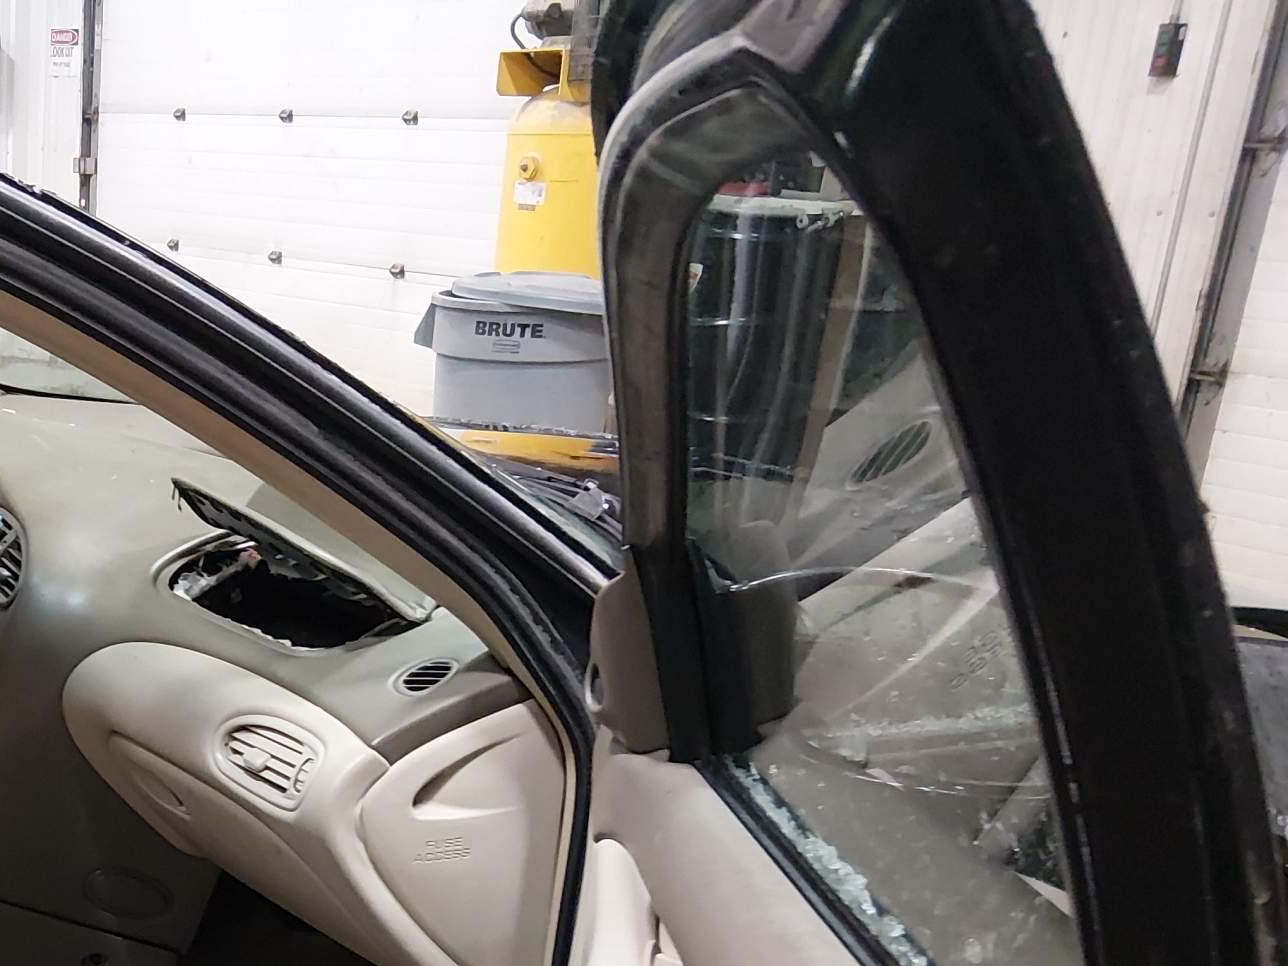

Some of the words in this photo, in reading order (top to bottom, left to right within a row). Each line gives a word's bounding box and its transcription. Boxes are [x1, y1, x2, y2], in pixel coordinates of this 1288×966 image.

[474, 320, 545, 339] BRUTE
[424, 836, 464, 850] FUSE
[412, 847, 473, 865] ACCESS
